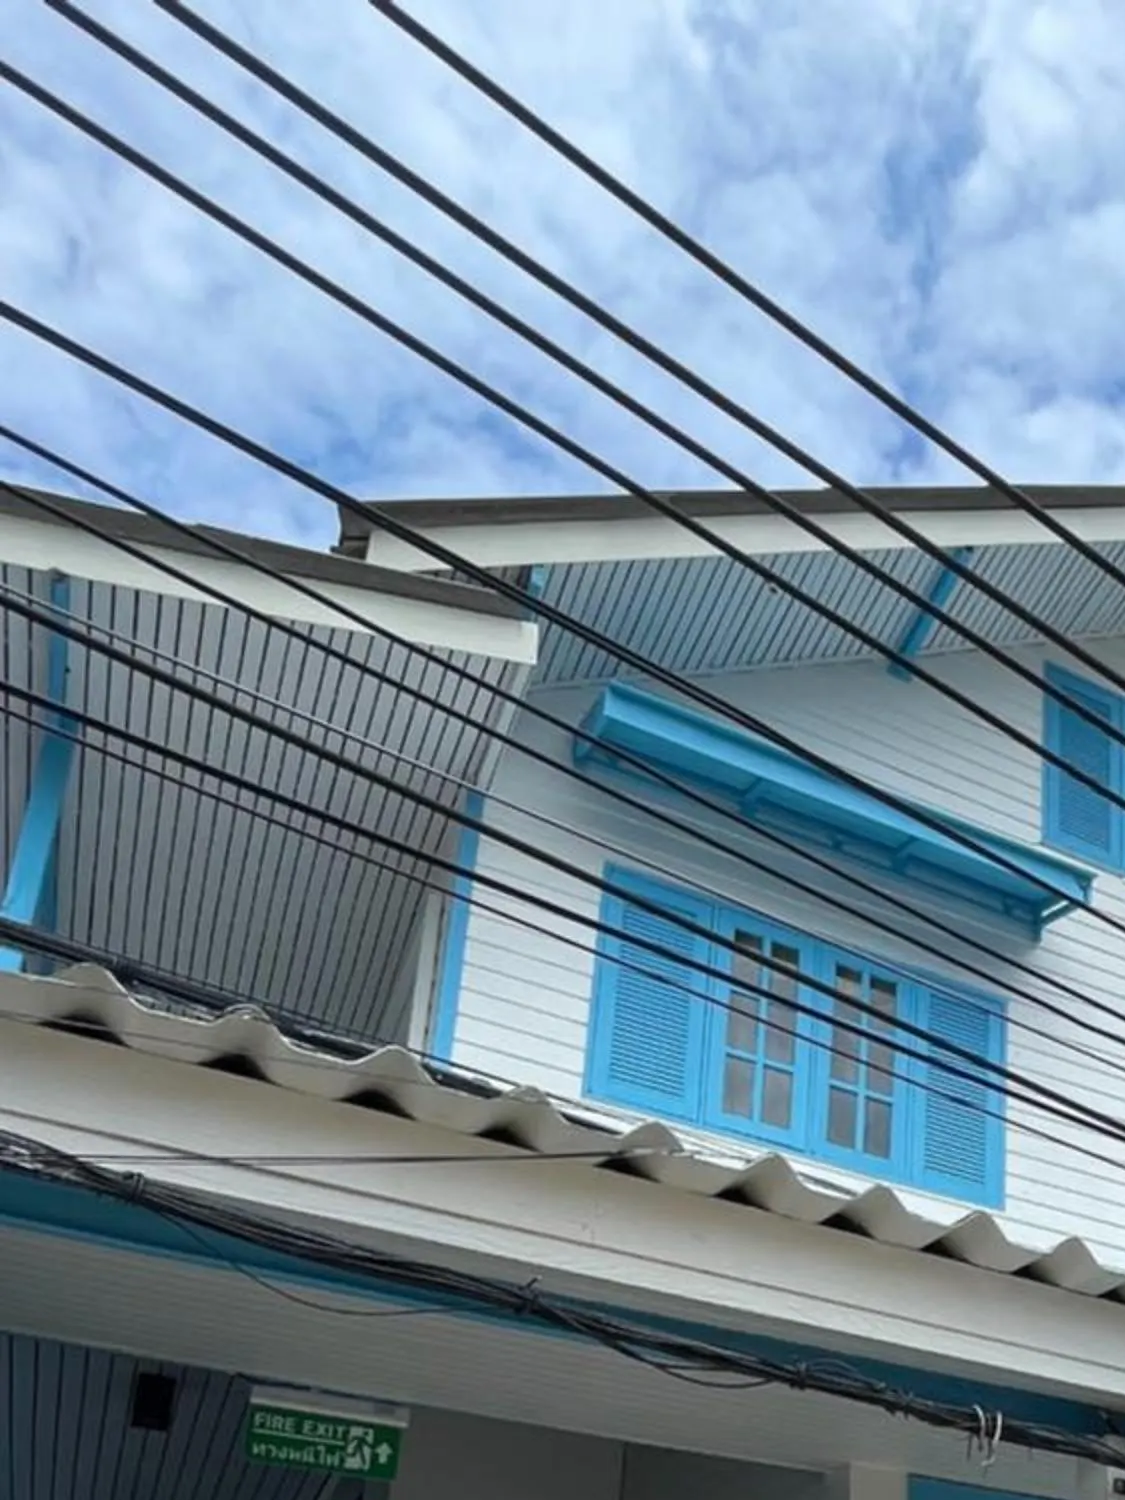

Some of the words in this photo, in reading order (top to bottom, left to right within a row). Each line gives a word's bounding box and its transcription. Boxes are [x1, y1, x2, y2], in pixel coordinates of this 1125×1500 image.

[254, 1411, 296, 1432] FIRE
[302, 1419, 348, 1440] EXIT
[252, 1442, 342, 1467] ทางหนีไฟ
